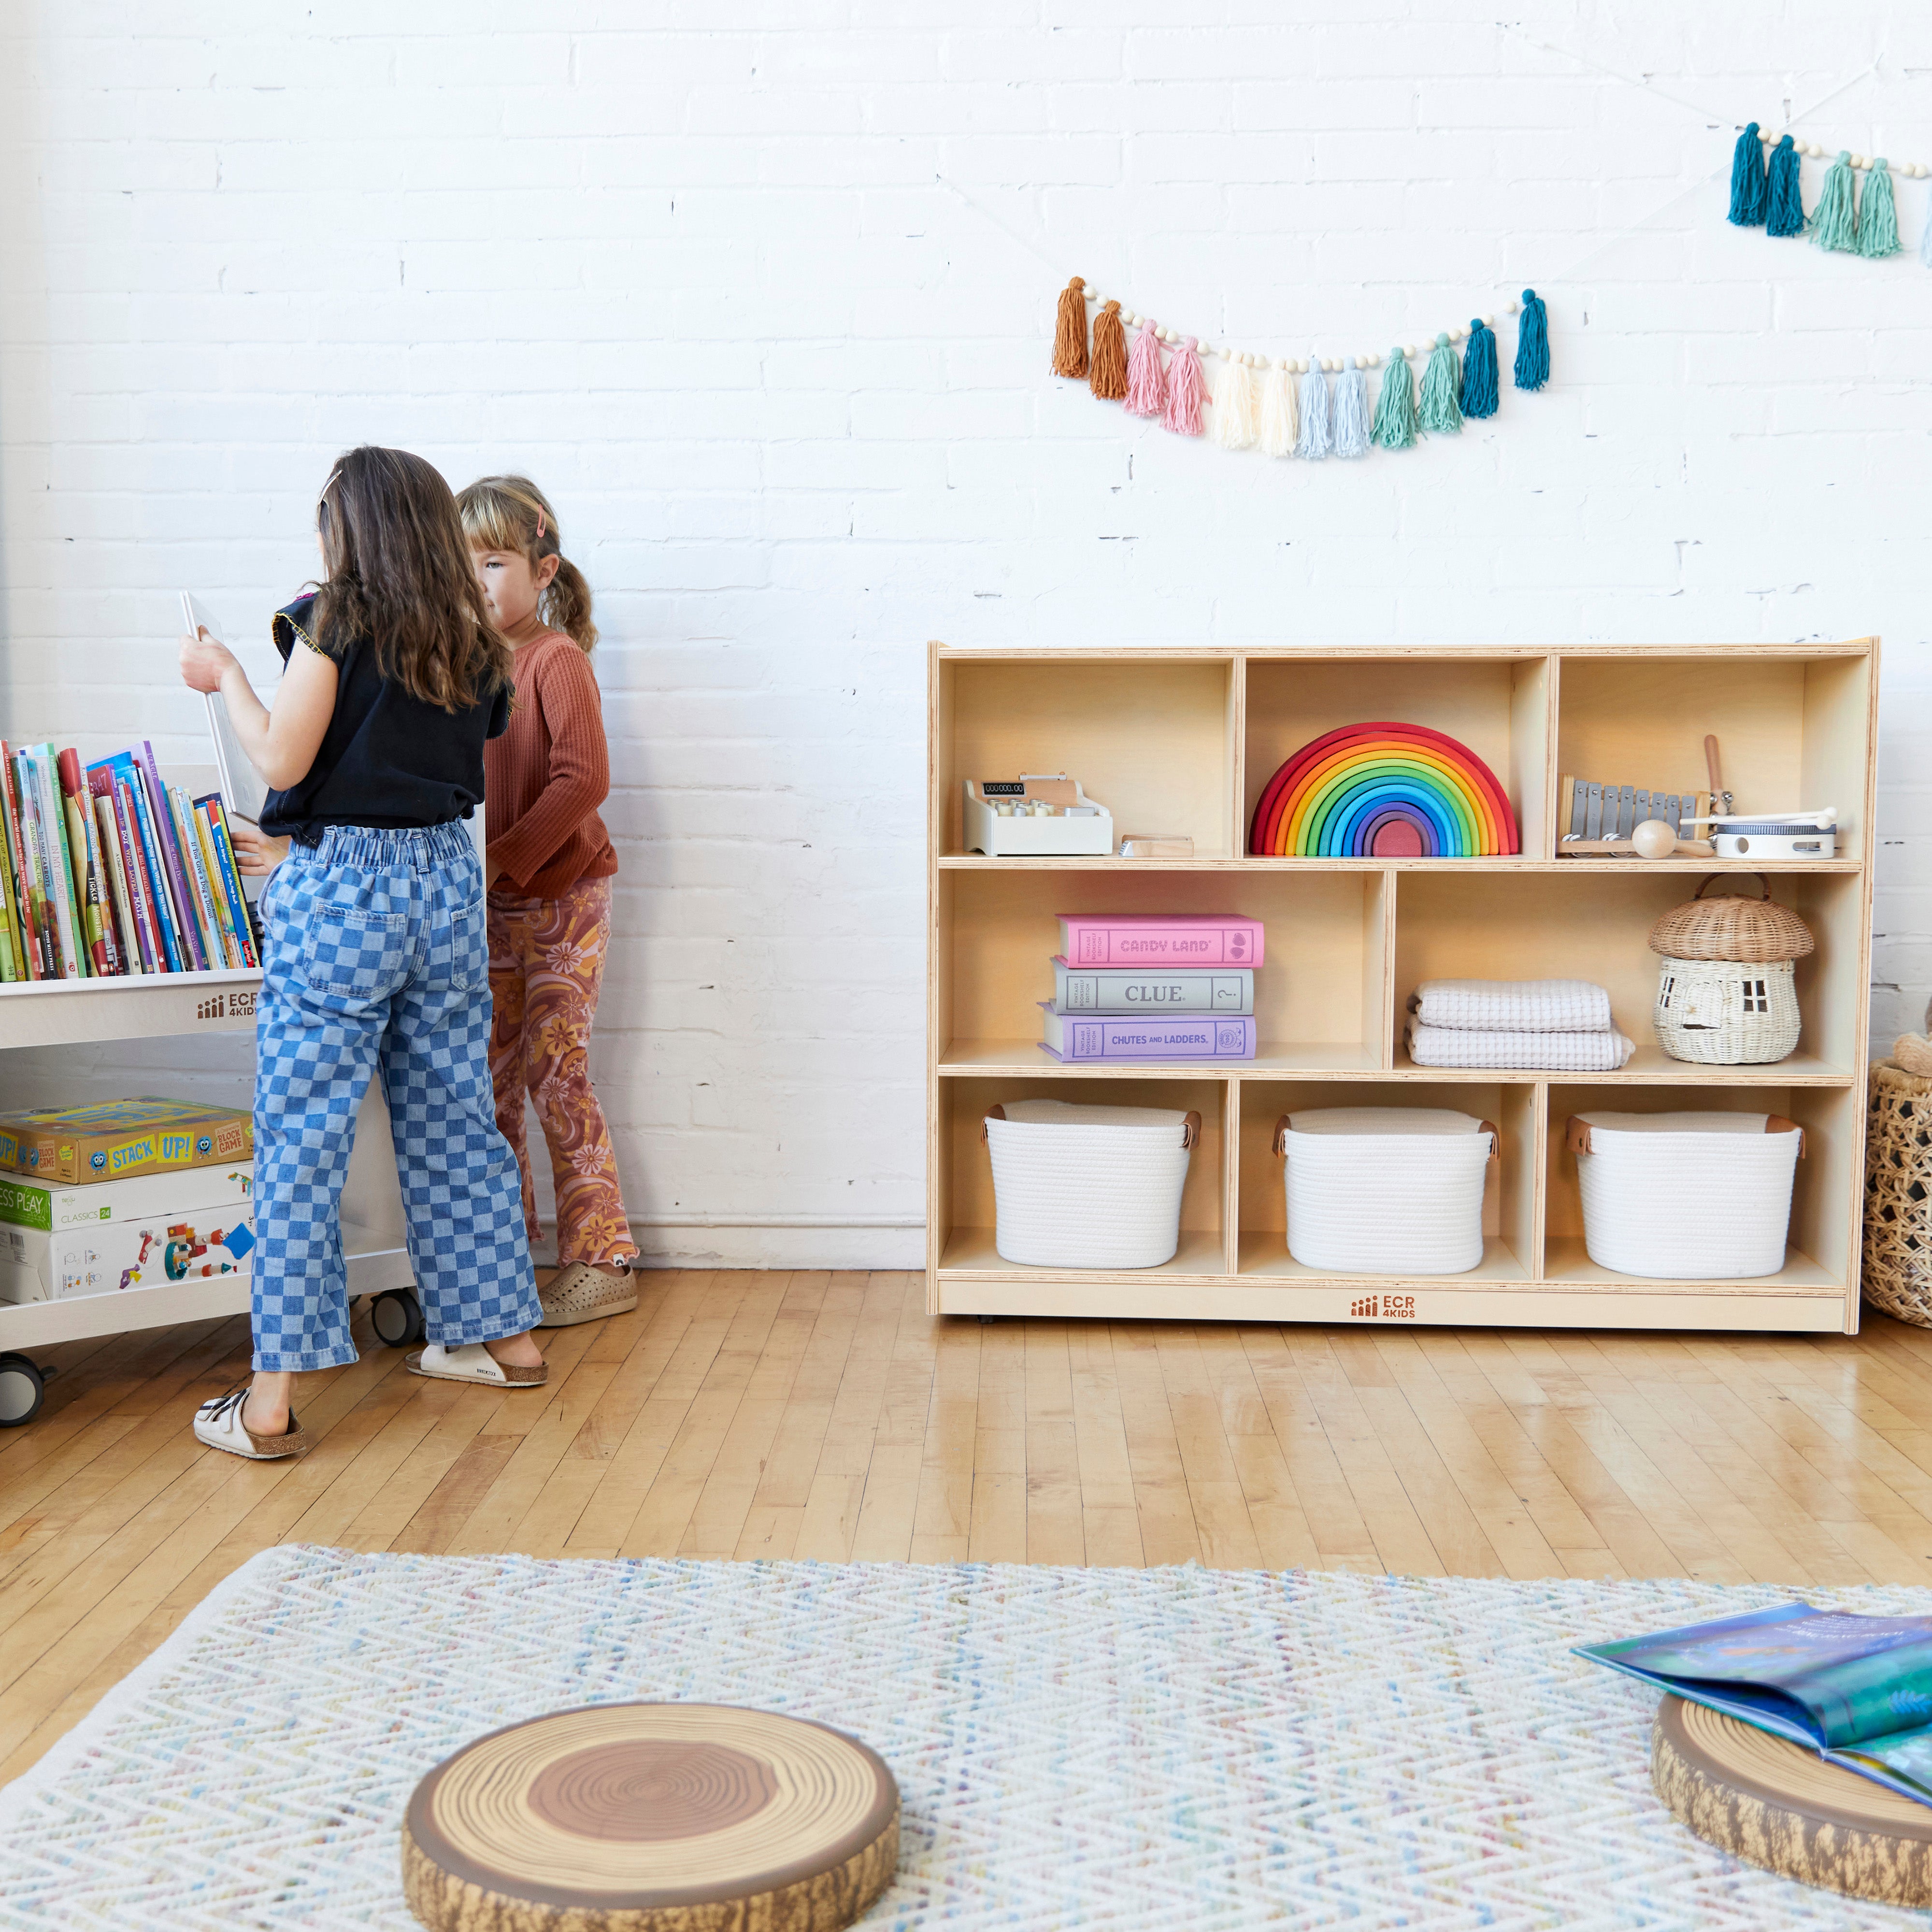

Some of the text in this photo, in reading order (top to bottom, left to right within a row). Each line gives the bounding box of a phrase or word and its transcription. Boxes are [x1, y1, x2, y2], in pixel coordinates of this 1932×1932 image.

[88, 822, 97, 850] DRAGONS
[121, 830, 129, 844] BOY
[29, 822, 43, 884] GRANDPA'S TRACTOR
[61, 842, 68, 850] My
[42, 857, 51, 887] CARROTS
[51, 846, 66, 900] IN MY HEART
[63, 853, 72, 881] Adventure
[129, 870, 138, 892] LOVED
[141, 866, 150, 892] MAGNIFICENT
[217, 878, 228, 902] GILCHRIST
[133, 896, 143, 919] MATH
[205, 900, 214, 919] Donut
[1120, 940, 1168, 952] CANDY
[244, 945, 252, 962] Ladybird
[229, 993, 258, 1006] ECR
[229, 1007, 257, 1016] 4KID
[1112, 1035, 1147, 1045] CHUTES
[217, 1129, 241, 1143] BLOCK
[39, 1147, 54, 1157] BLOCK
[113, 1136, 190, 1169] STACK UP!
[219, 1138, 242, 1153] GAME
[39, 1157, 55, 1169] GAME
[17, 1192, 43, 1214] PLAY
[62, 1195, 75, 1206] tegu
[61, 1209, 110, 1223] CLASSICS 24
[1384, 1296, 1415, 1308] ECR
[1383, 1309, 1415, 1318] 4KIDS
[476, 1368, 496, 1376] BIRKENSTOCK
